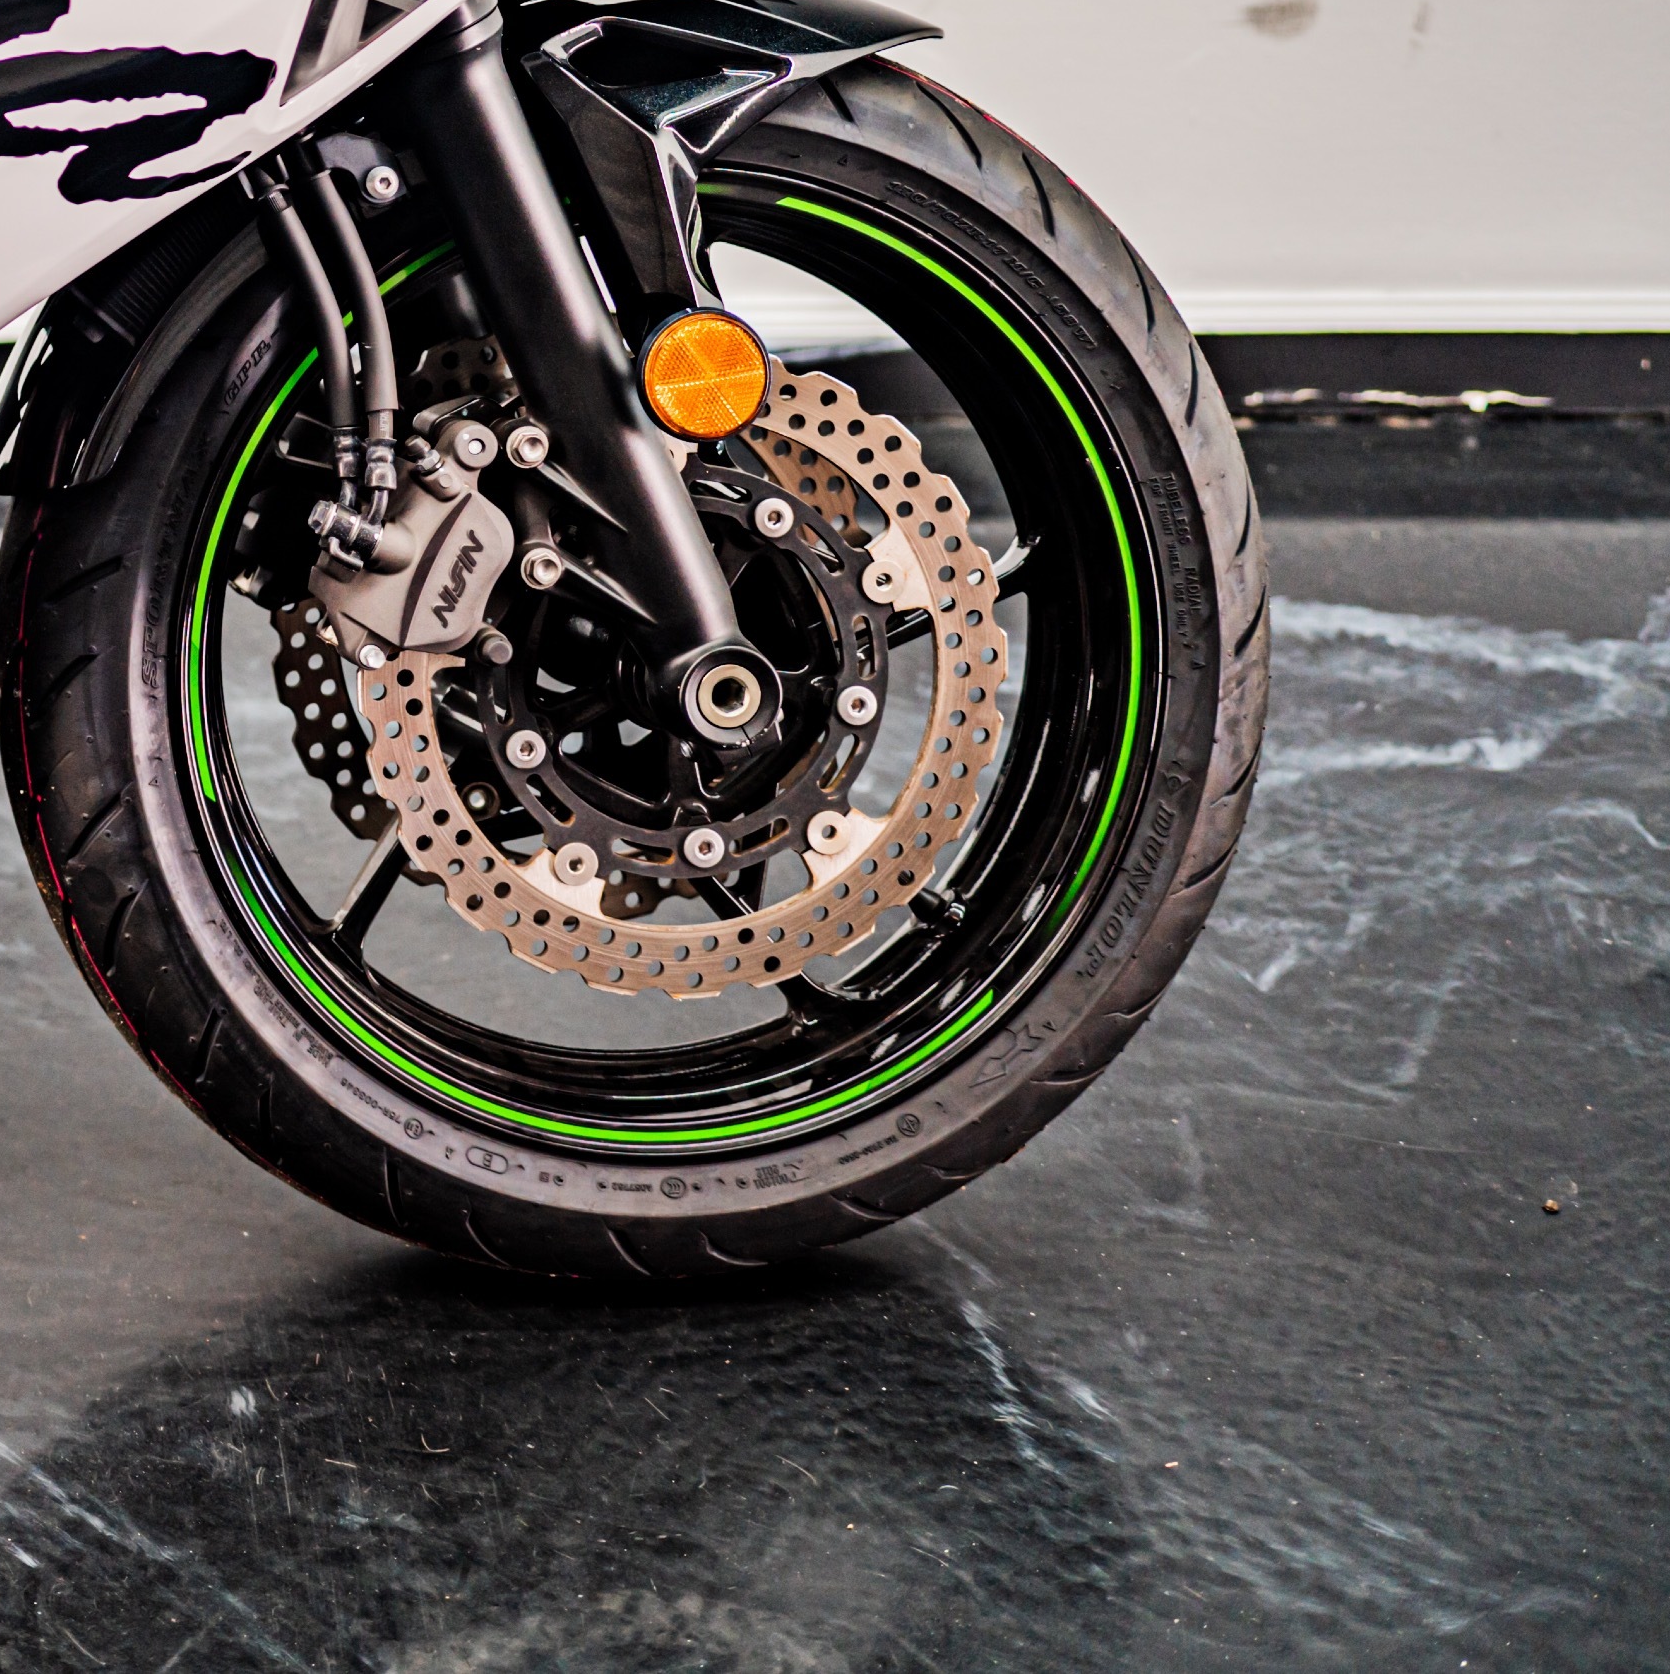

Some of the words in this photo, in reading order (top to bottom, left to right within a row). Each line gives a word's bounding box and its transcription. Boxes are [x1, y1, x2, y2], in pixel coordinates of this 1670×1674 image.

[430, 529, 484, 629] NISSIN
[1161, 472, 1192, 544] TUBELESS
[1184, 565, 1201, 613] RADIAL
[1084, 800, 1177, 978] DUNLOP
